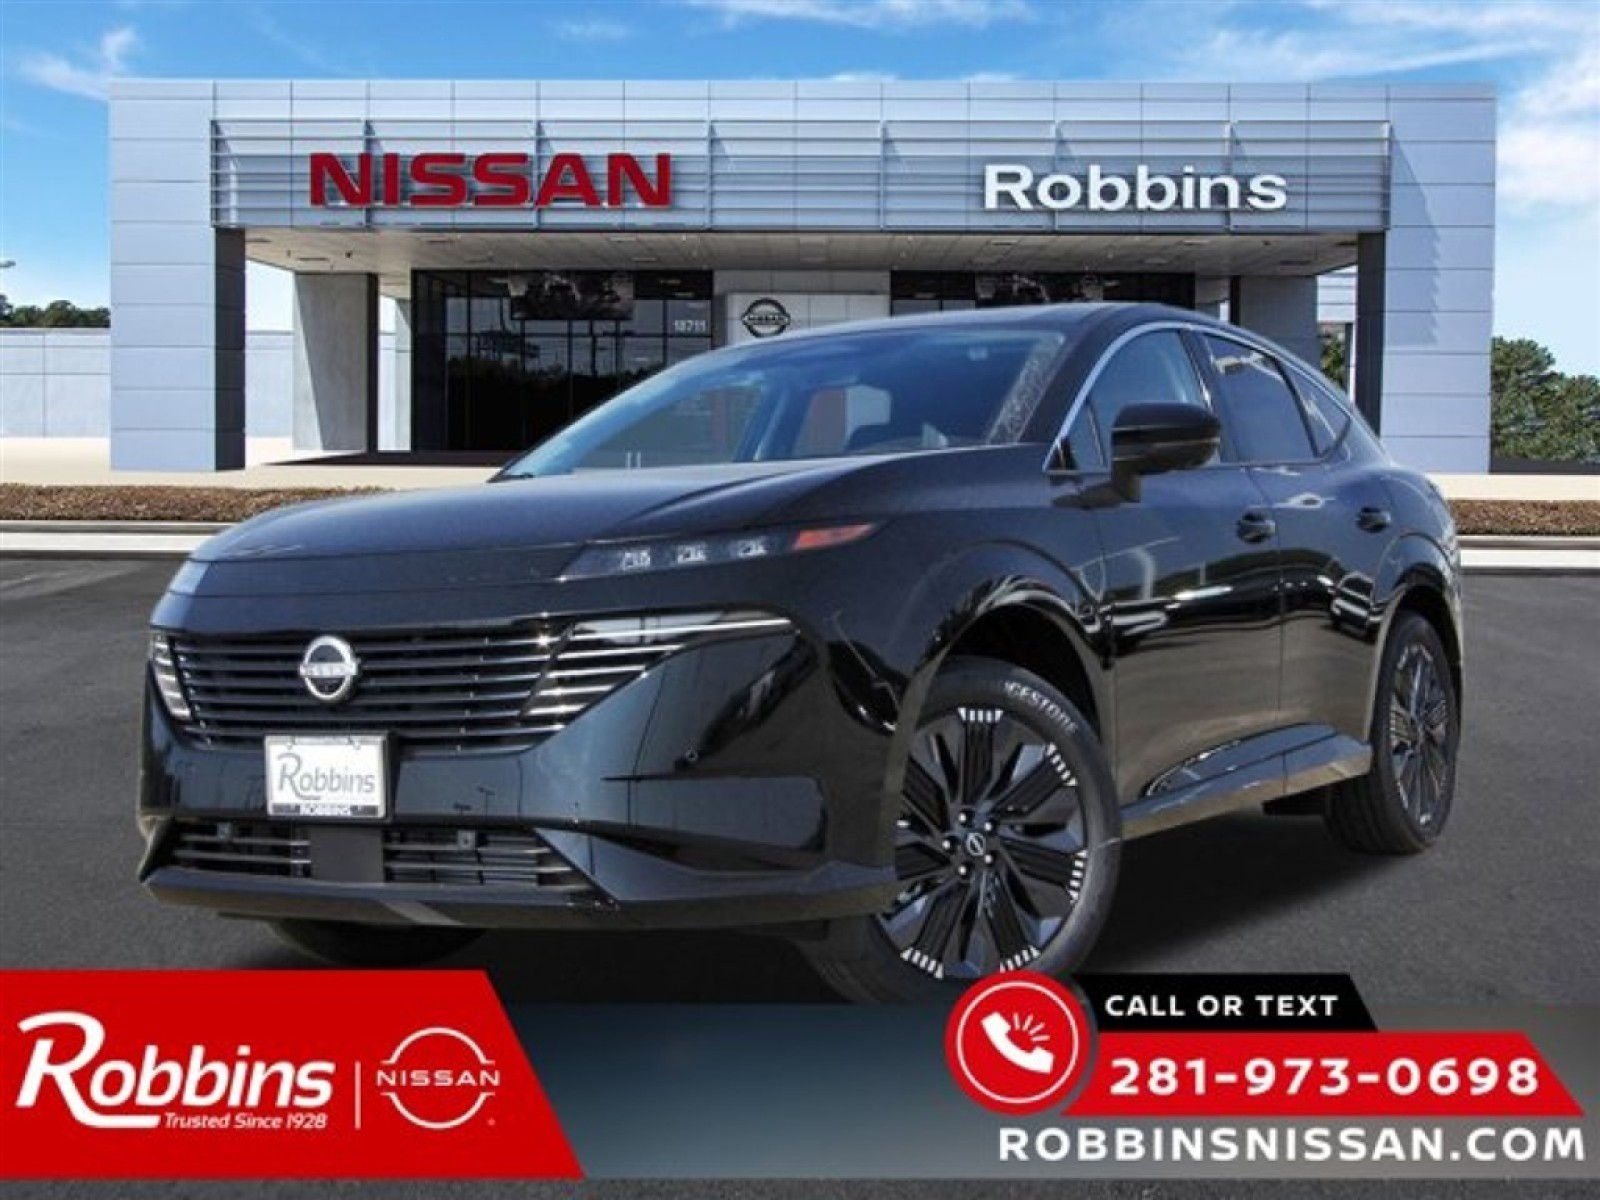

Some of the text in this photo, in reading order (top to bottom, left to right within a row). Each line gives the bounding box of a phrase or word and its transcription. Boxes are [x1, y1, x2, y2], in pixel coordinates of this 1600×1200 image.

[309, 152, 672, 207] NISSAN
[983, 163, 1288, 211] Robbins
[277, 752, 376, 801] Robbins
